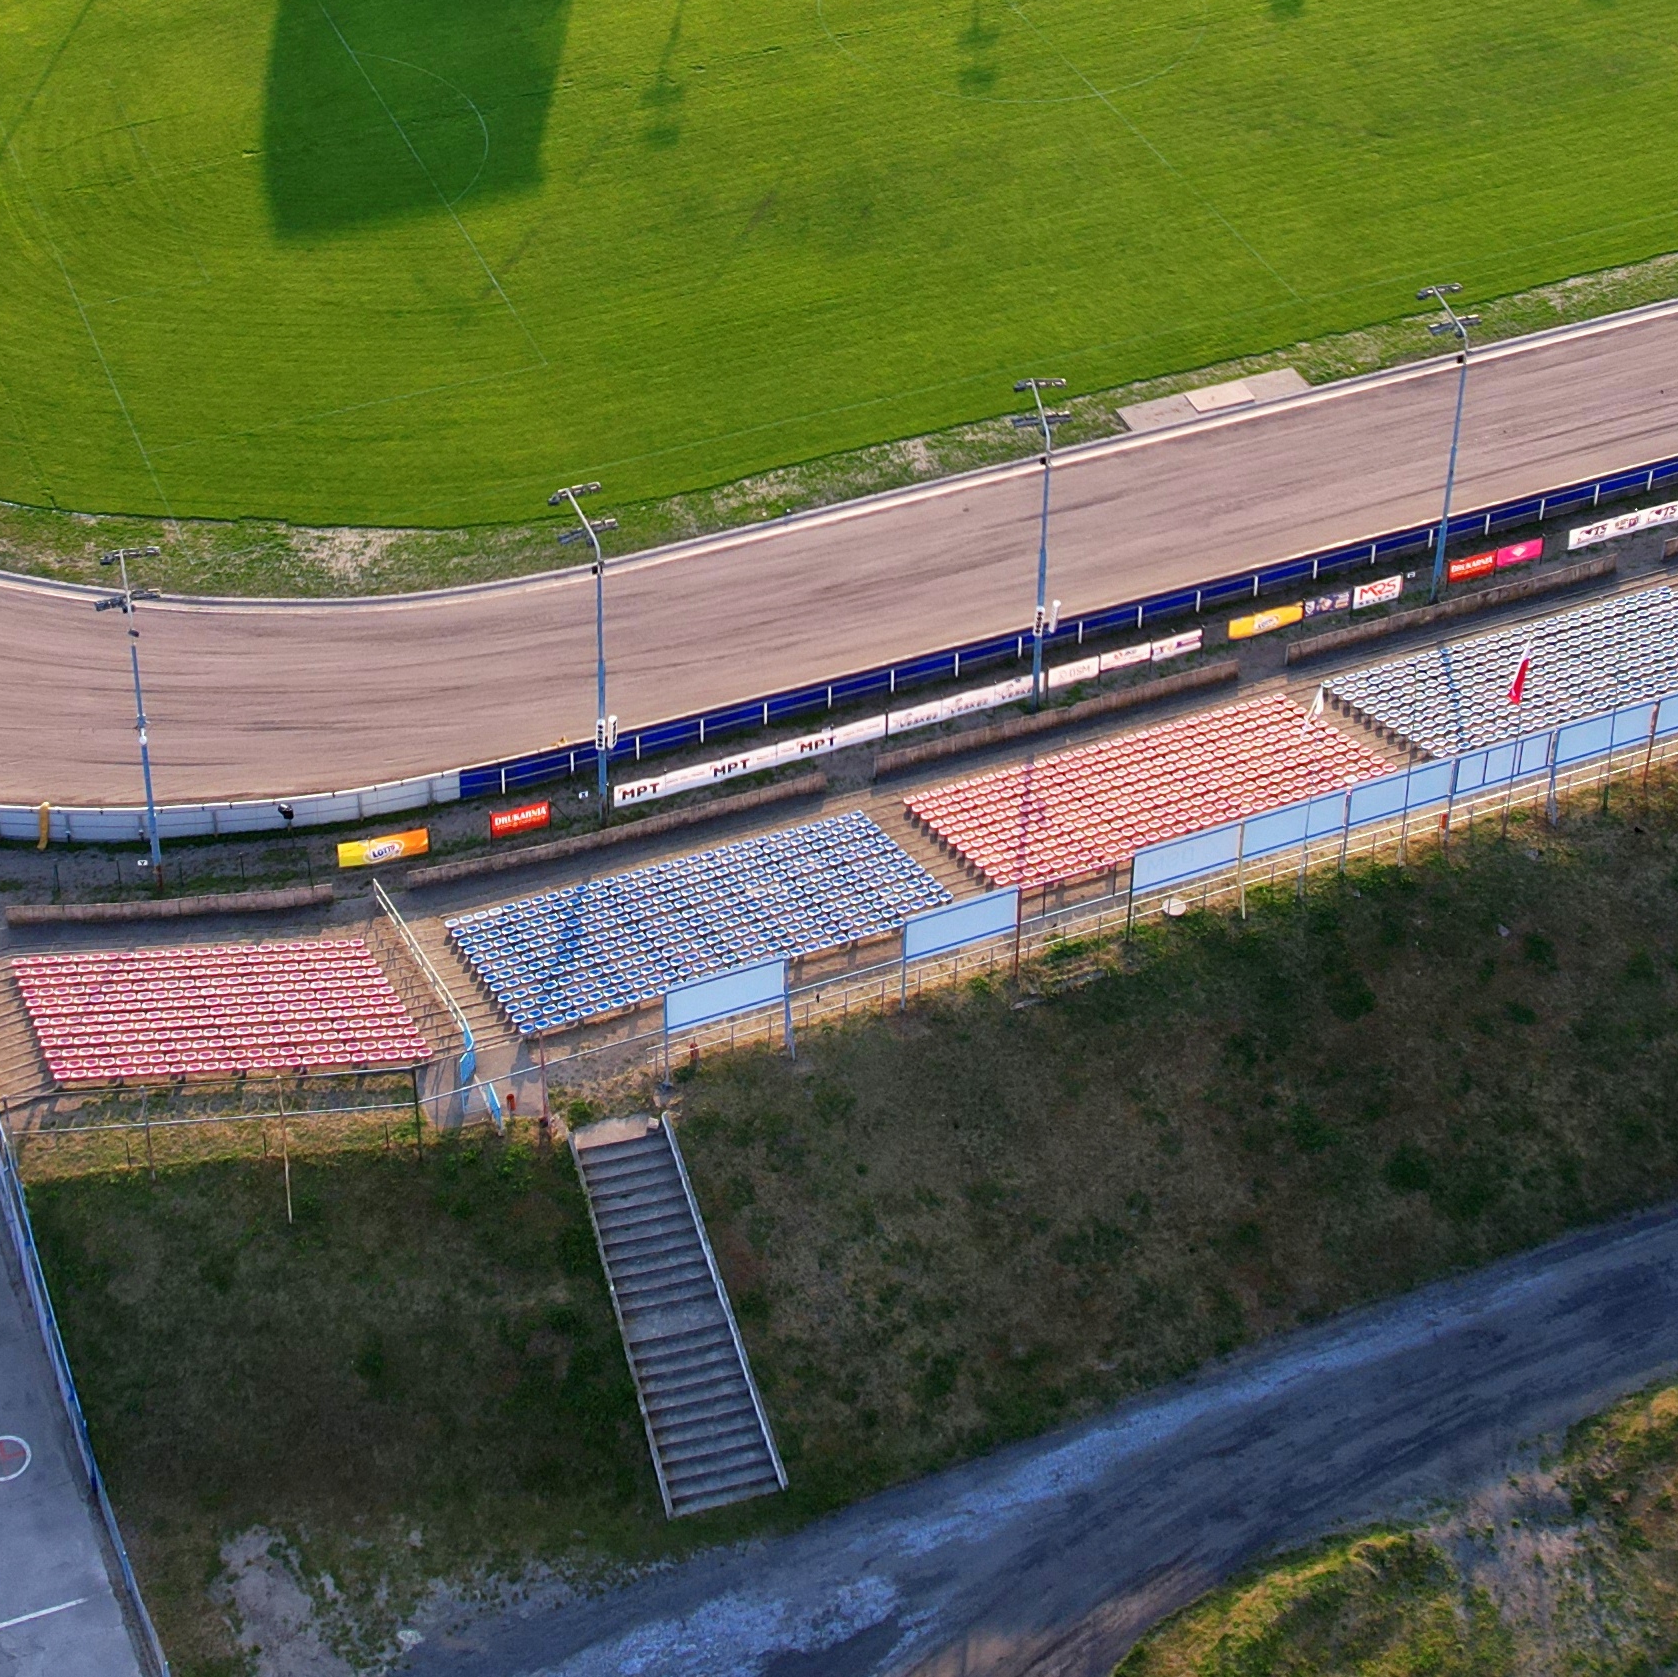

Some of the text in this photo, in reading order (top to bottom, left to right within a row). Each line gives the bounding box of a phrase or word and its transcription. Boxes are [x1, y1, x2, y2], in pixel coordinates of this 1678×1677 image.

[799, 736, 837, 754] MPT
[713, 758, 751, 778] MPT
[621, 782, 661, 801] MPT
[371, 844, 396, 859] LOTTO
